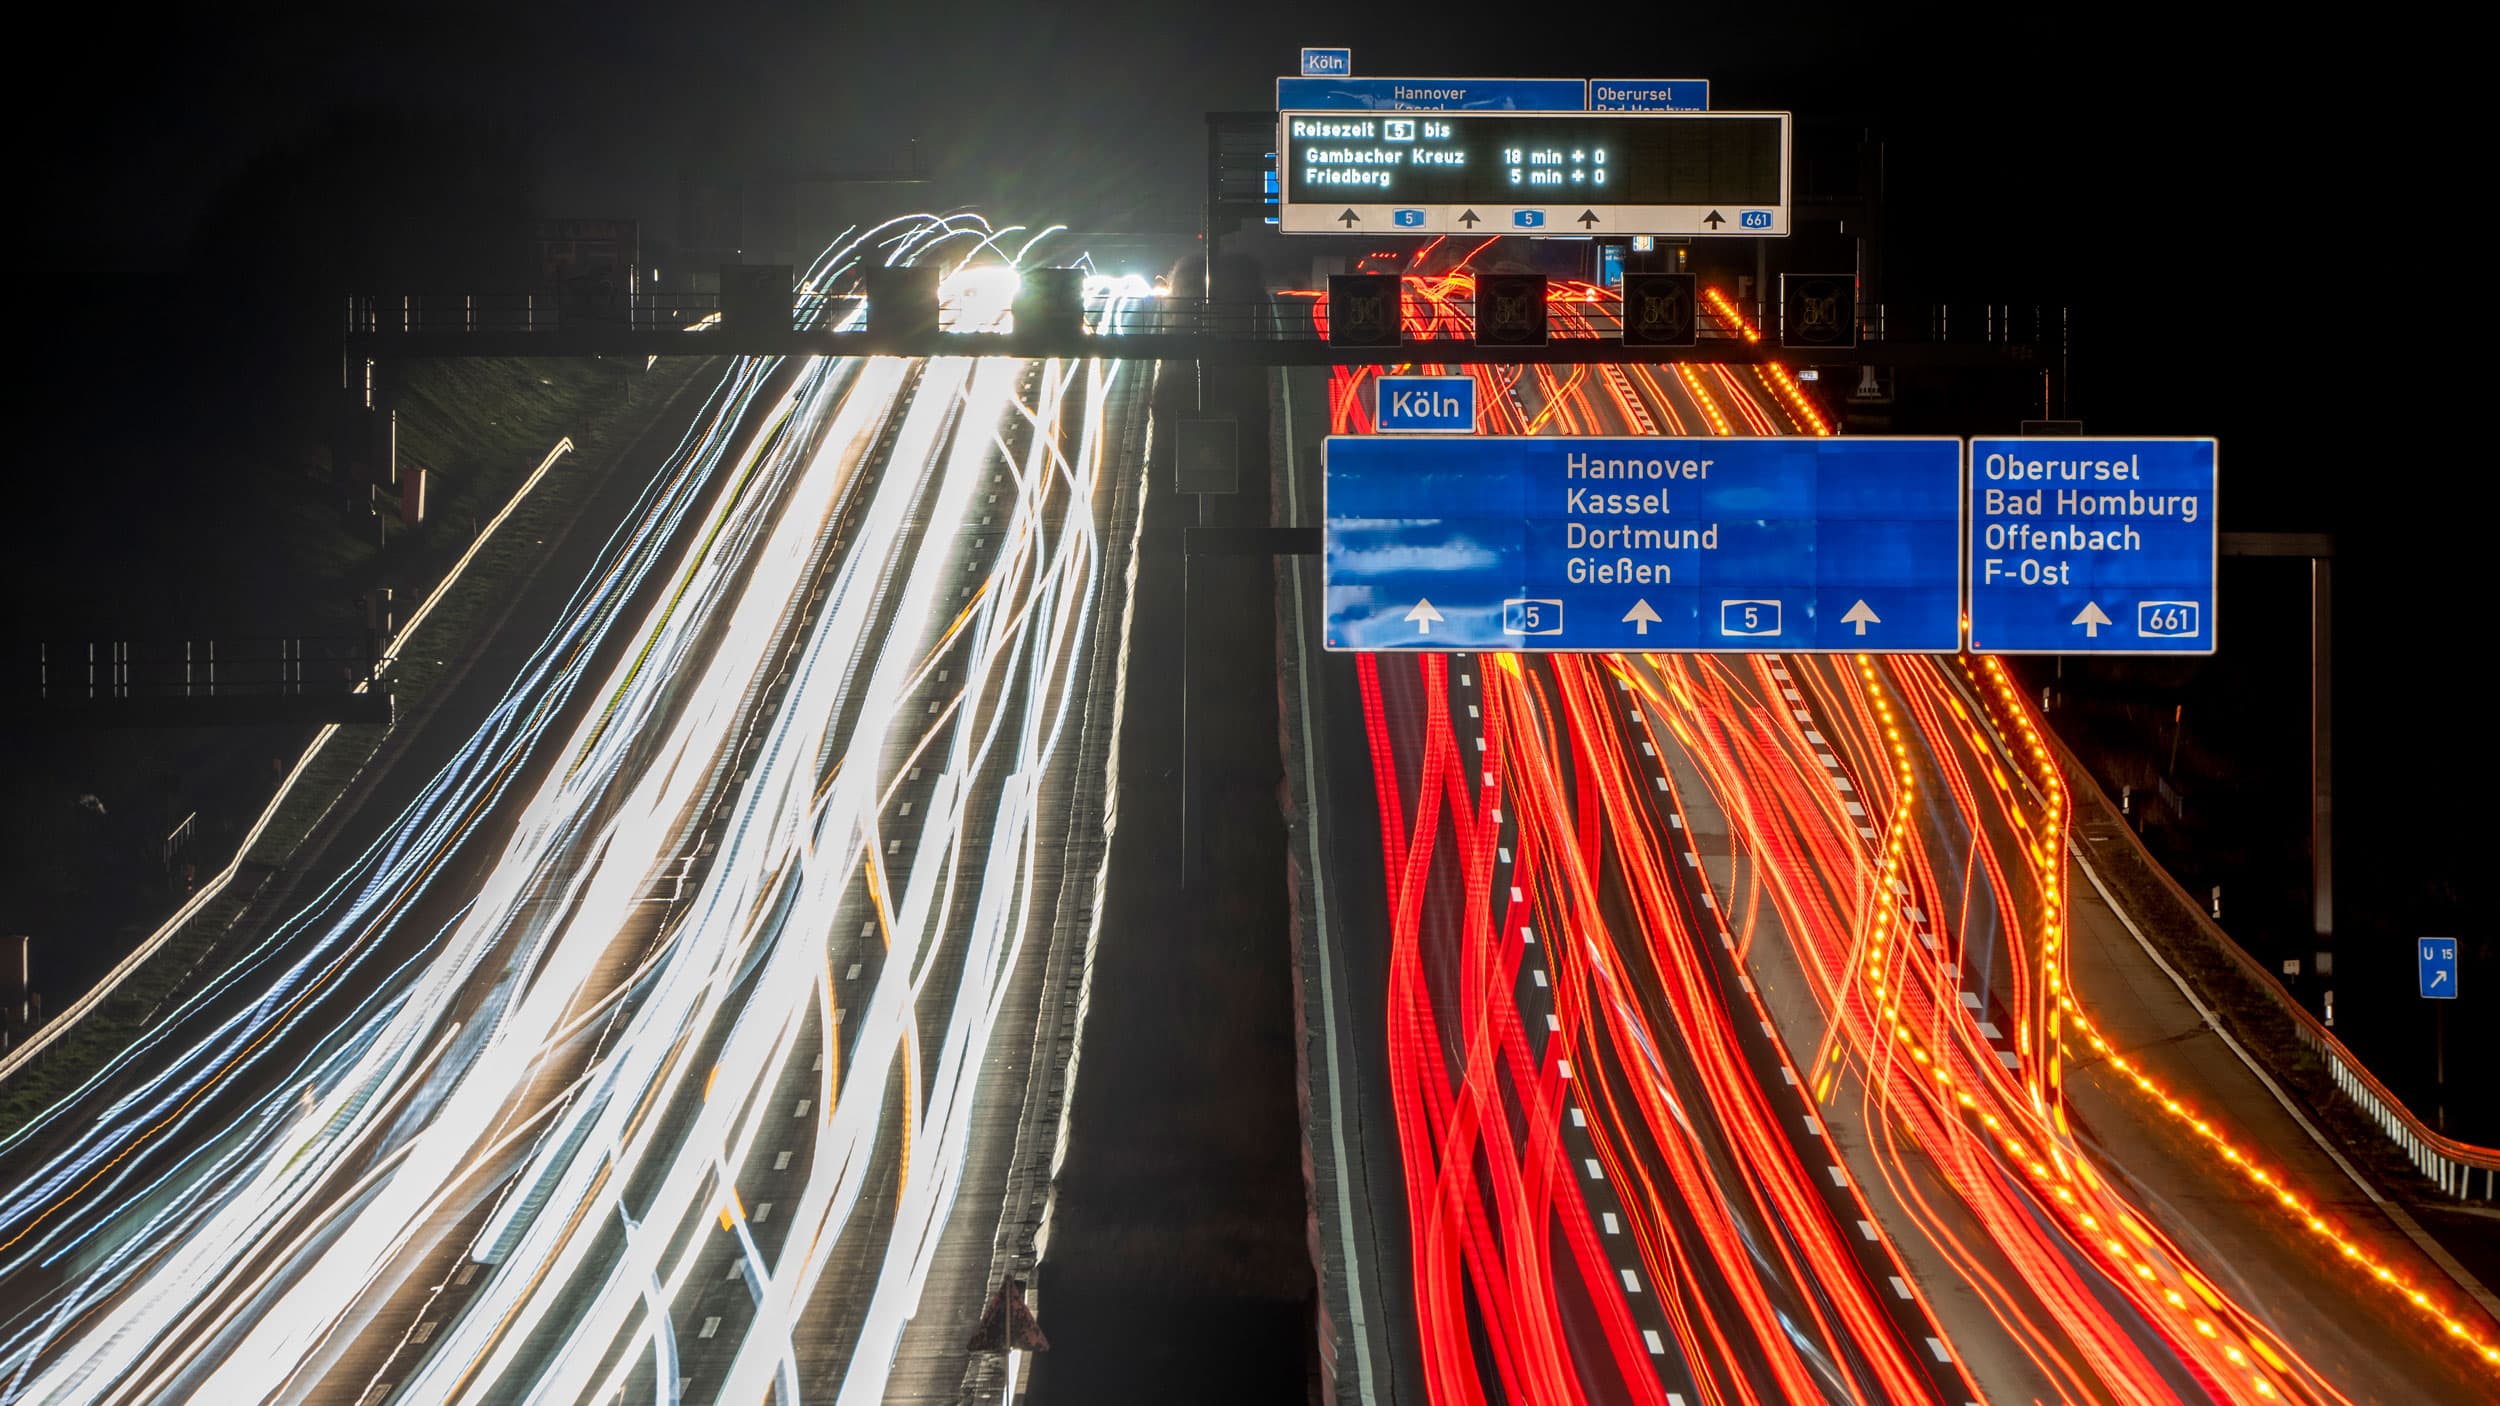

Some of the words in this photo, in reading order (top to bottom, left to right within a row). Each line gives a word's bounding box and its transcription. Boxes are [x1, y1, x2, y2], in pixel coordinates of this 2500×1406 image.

[1309, 55, 1343, 69] Köln
[1394, 86, 1466, 100] Hannover
[1597, 87, 1672, 101] Oberursel
[1294, 121, 1375, 137] Reisezeit
[1394, 123, 1405, 137] 5
[1424, 122, 1450, 137] bis
[1306, 148, 1402, 163] Gambacher
[1412, 148, 1465, 164] Kreuz
[1504, 149, 1521, 164] 18
[1531, 149, 1562, 164] min
[1594, 149, 1605, 164] 0
[1306, 168, 1390, 187] Friedberg
[1511, 169, 1521, 183] 5
[1531, 169, 1562, 184] min
[1594, 169, 1605, 184] 0
[1405, 212, 1413, 225] 5
[1525, 213, 1533, 226] 5
[1746, 214, 1767, 226] 661
[1393, 391, 1460, 418] Köln
[1567, 453, 1714, 480] Hannover
[1985, 453, 2140, 481] Oberursel
[1567, 488, 1670, 514] Kassel
[1985, 489, 2042, 515] Bad
[2057, 489, 2198, 523] Homburg
[1567, 522, 1718, 550] Dortmund
[1985, 524, 2141, 551] Offenbach
[1567, 557, 1671, 584] Gießen
[1985, 558, 2070, 585] F-Ost
[1527, 606, 1540, 628] 5
[1745, 607, 1758, 629] 5
[2150, 608, 2188, 630] 661
[2423, 946, 2434, 960] U
[2442, 948, 2453, 960] 15
